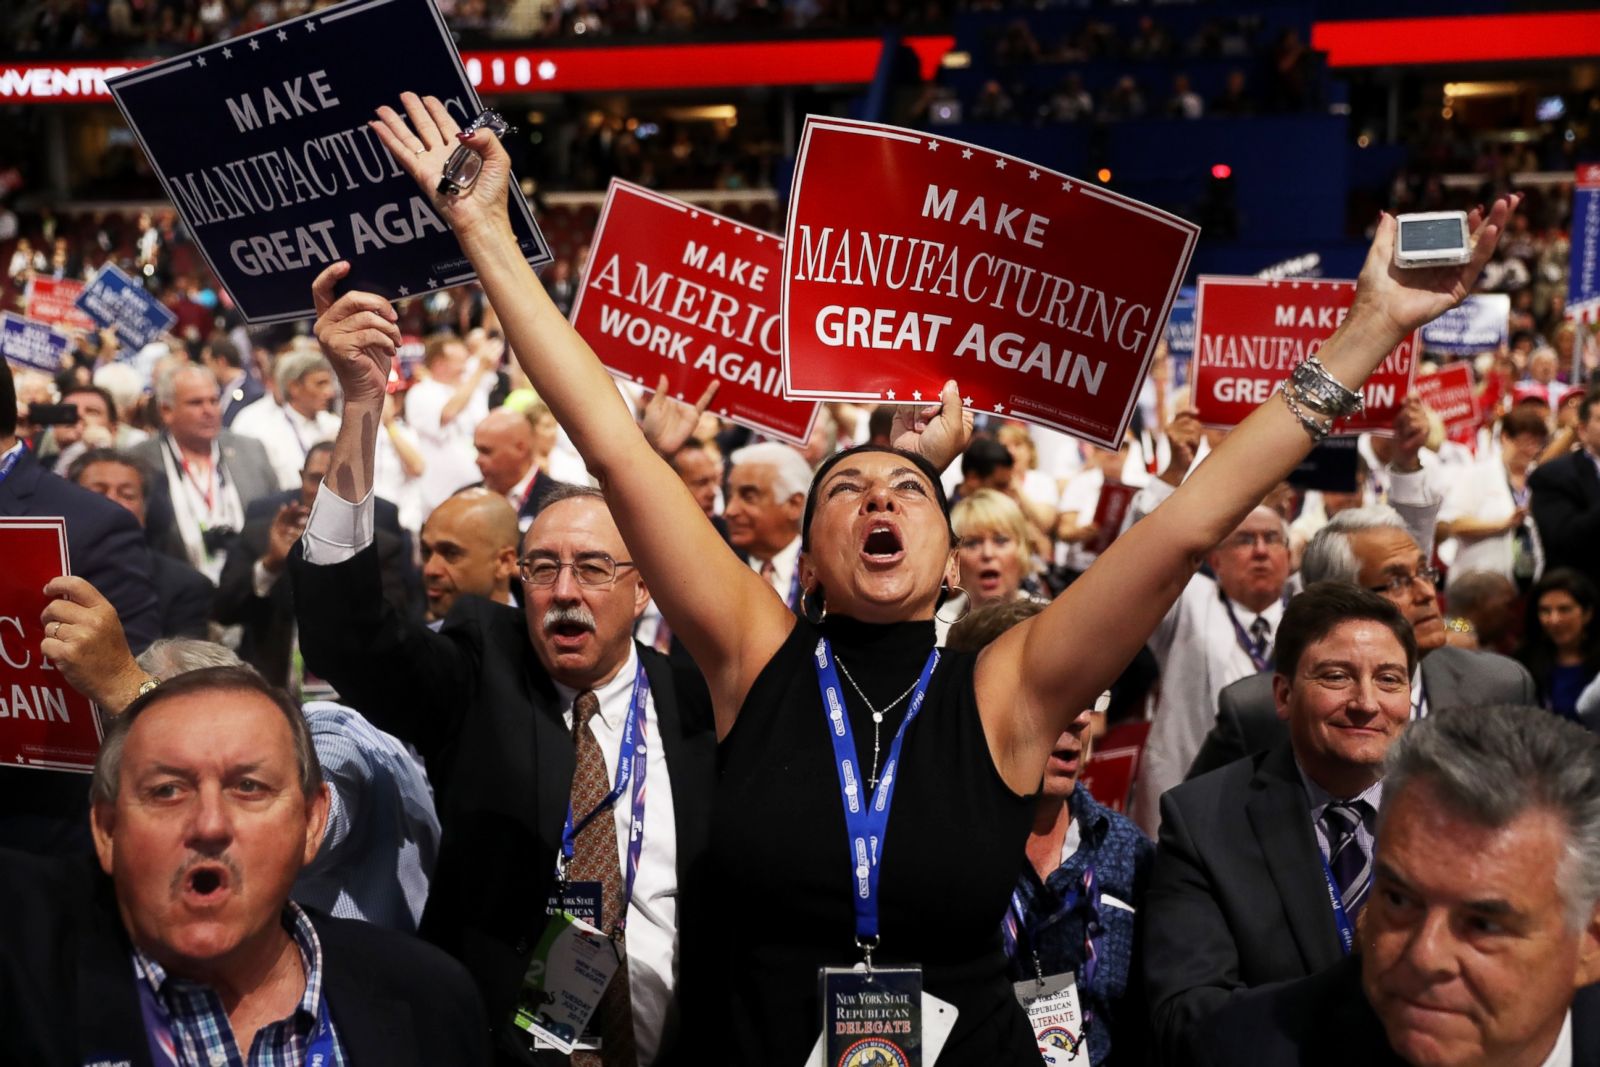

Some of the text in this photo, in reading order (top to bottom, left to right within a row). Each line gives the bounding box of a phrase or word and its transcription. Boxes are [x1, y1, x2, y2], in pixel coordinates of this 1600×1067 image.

[225, 69, 340, 133] MAKE
[169, 96, 469, 227] MANUFACTU
[921, 183, 1050, 249] MAKE
[229, 196, 456, 276] GREAT AGA
[682, 240, 769, 292] MAKE
[794, 225, 1151, 354] MANUFACTURING
[590, 253, 782, 356] AMERIC
[1275, 305, 1349, 329] MAKE
[600, 304, 693, 364] WORK
[815, 304, 952, 352] GREAT
[953, 322, 1108, 396] AGAIN
[548, 897, 558, 905] EW
[563, 897, 576, 905] ORK
[524, 959, 545, 985] 2
[560, 989, 593, 1012] TUESDAY
[562, 1001, 579, 1013] JULY
[836, 992, 910, 1005] NEW YORK STATE
[1025, 1001, 1072, 1016] REPUBLICAN
[1037, 993, 1053, 1002] YORK
[1053, 990, 1070, 1000] STATE
[836, 1007, 909, 1019] REPUBLICAN
[1032, 1011, 1075, 1029] LTERNATE
[835, 1020, 911, 1034] DELEGATE
